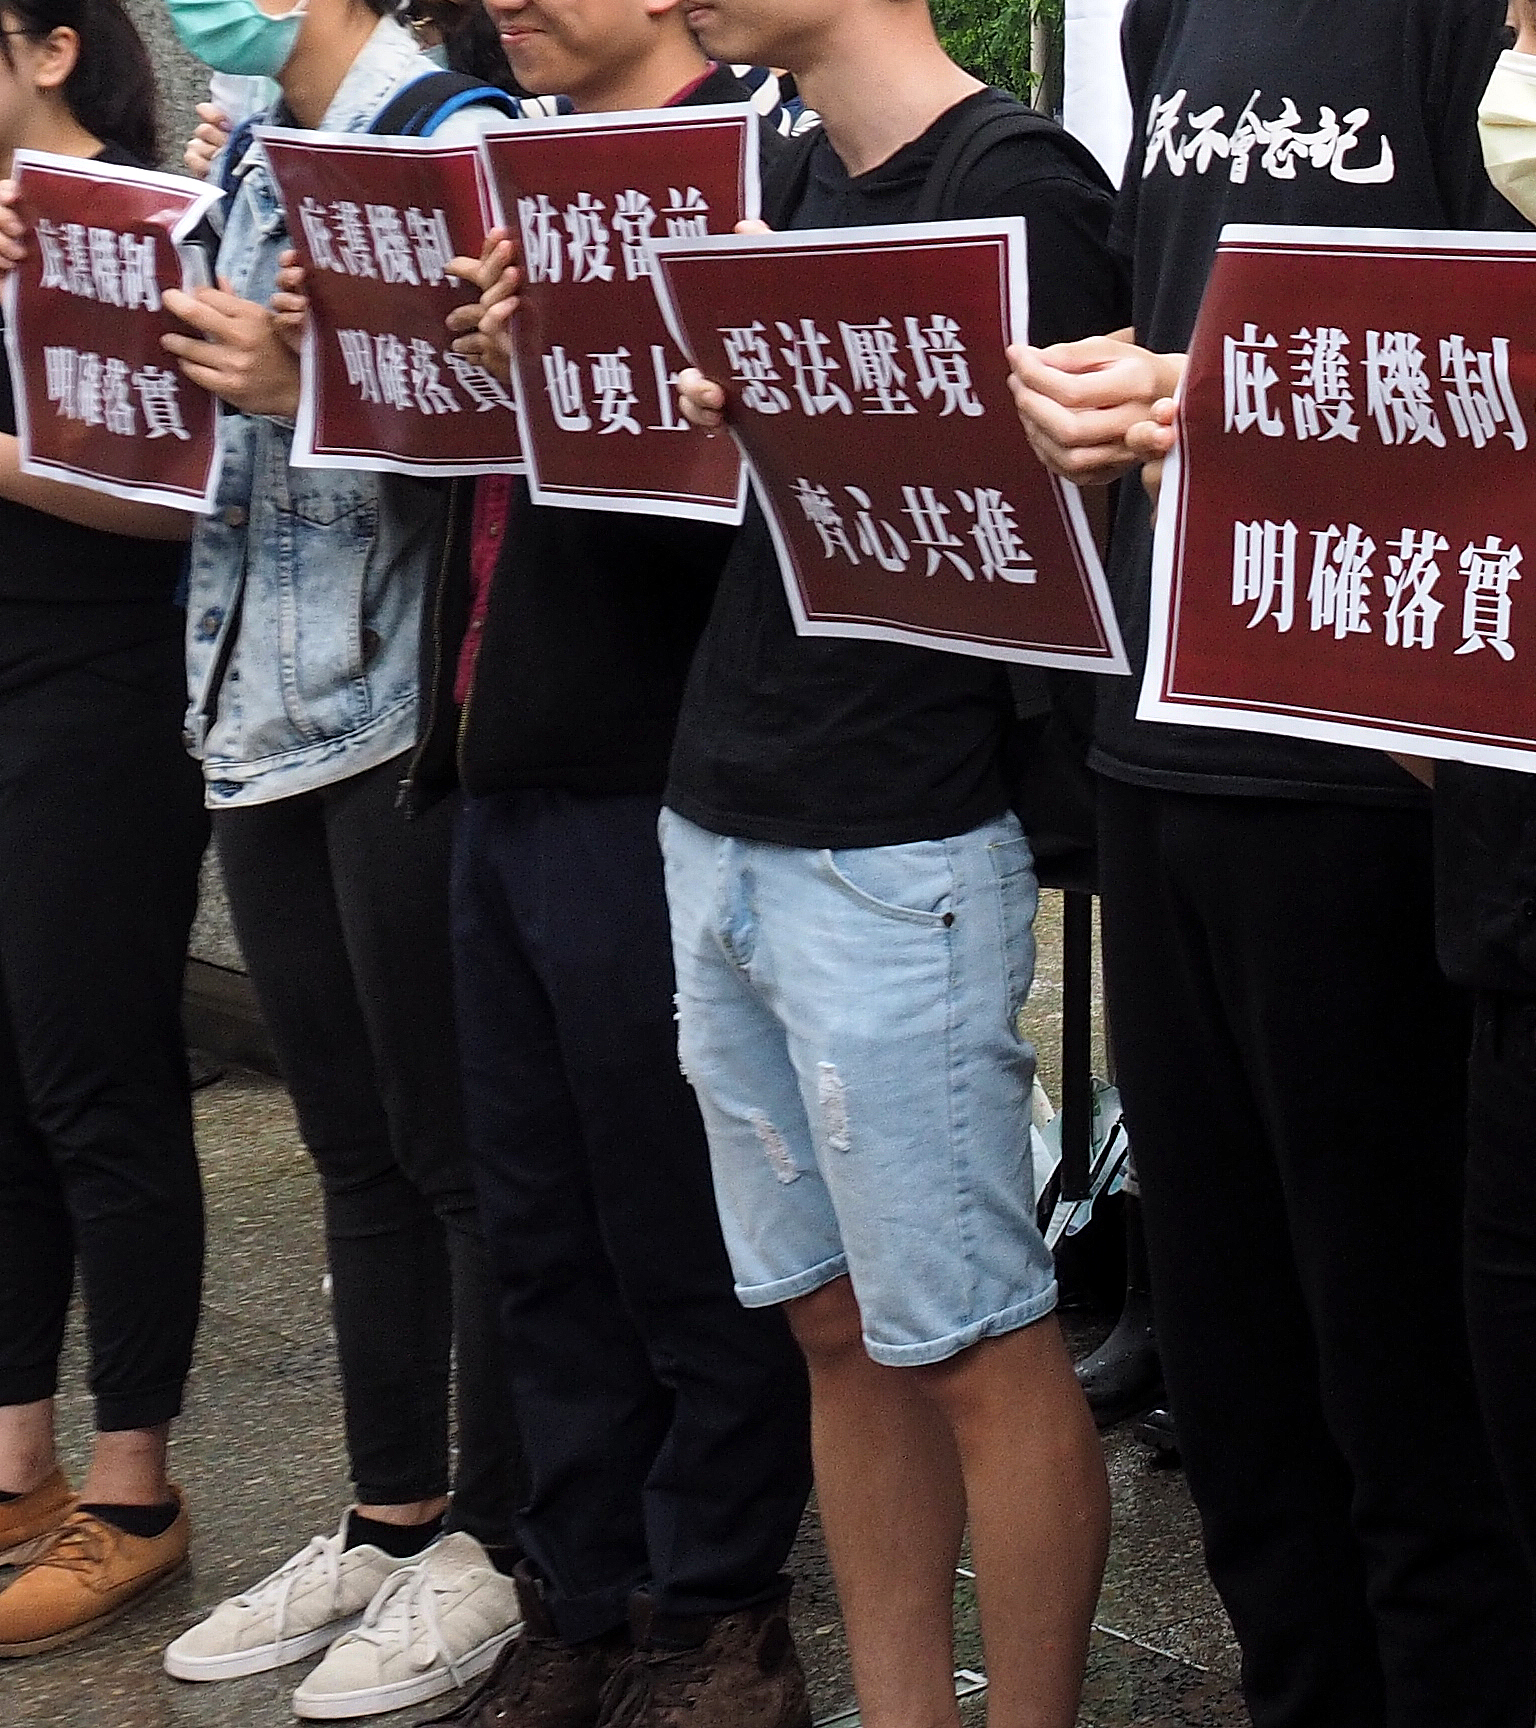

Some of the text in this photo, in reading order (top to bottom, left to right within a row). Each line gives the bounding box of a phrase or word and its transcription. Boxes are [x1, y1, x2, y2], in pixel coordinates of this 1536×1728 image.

[542, 344, 716, 437] 也要上
[717, 314, 985, 417] 惡法壓境
[1222, 322, 1528, 451] 庇護機制
[788, 476, 1038, 584] 齊心共進
[1231, 519, 1524, 661] 明確落實
